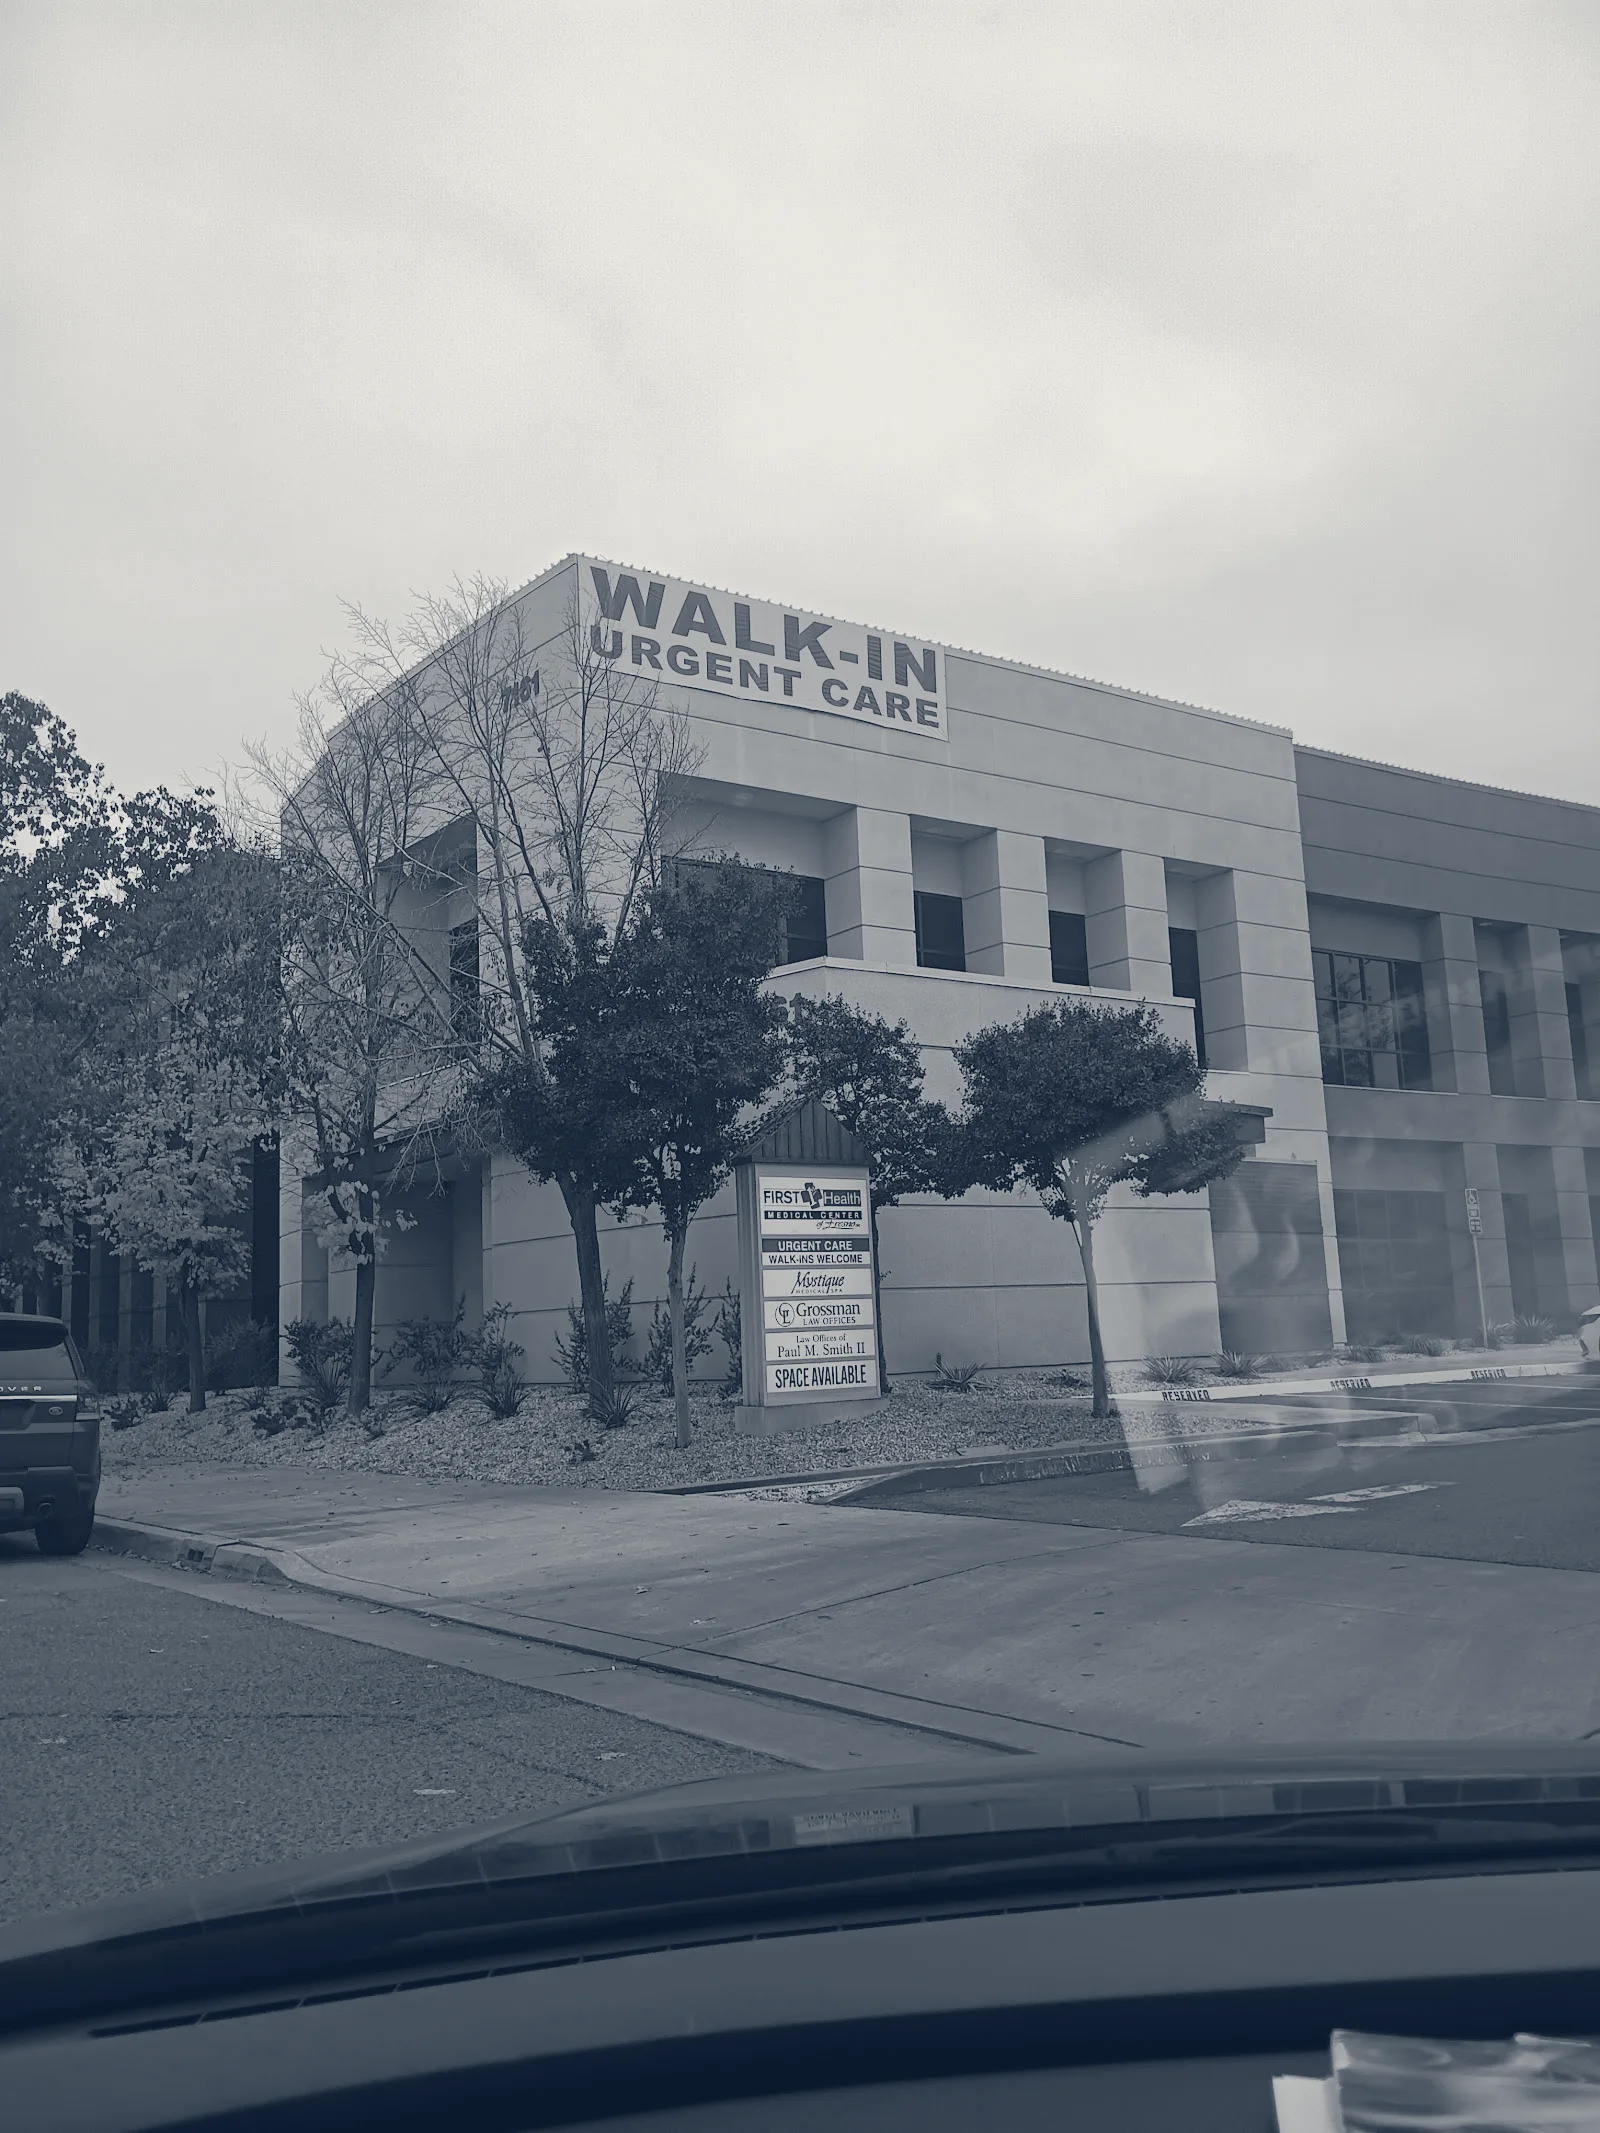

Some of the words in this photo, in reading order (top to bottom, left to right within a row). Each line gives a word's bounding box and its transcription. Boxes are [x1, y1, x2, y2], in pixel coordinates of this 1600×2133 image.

[590, 566, 937, 693] WALK-IN
[590, 624, 802, 696] URGENT
[821, 678, 940, 729] CARE
[763, 1190, 800, 1204] FIRST
[824, 1191, 861, 1204] Health
[823, 1218, 856, 1230] Fresno
[778, 1241, 822, 1252] URGENT
[824, 1240, 853, 1251] CARE
[768, 1254, 815, 1264] WALK-INS
[817, 1254, 863, 1263] WELCOME
[791, 1271, 845, 1294] Mystique
[796, 1303, 861, 1317] Grossman
[803, 1318, 820, 1326] LAW
[822, 1316, 856, 1325] OFFICES
[796, 1335, 811, 1343] Law
[812, 1334, 837, 1343] Offices
[839, 1333, 846, 1342] of
[777, 1345, 801, 1358] Paul
[805, 1344, 819, 1356] M.
[823, 1343, 853, 1356] Smith
[775, 1367, 810, 1389] SPACE
[812, 1365, 866, 1386] AVAILABLE
[1161, 1389, 1211, 1401] RESERVED
